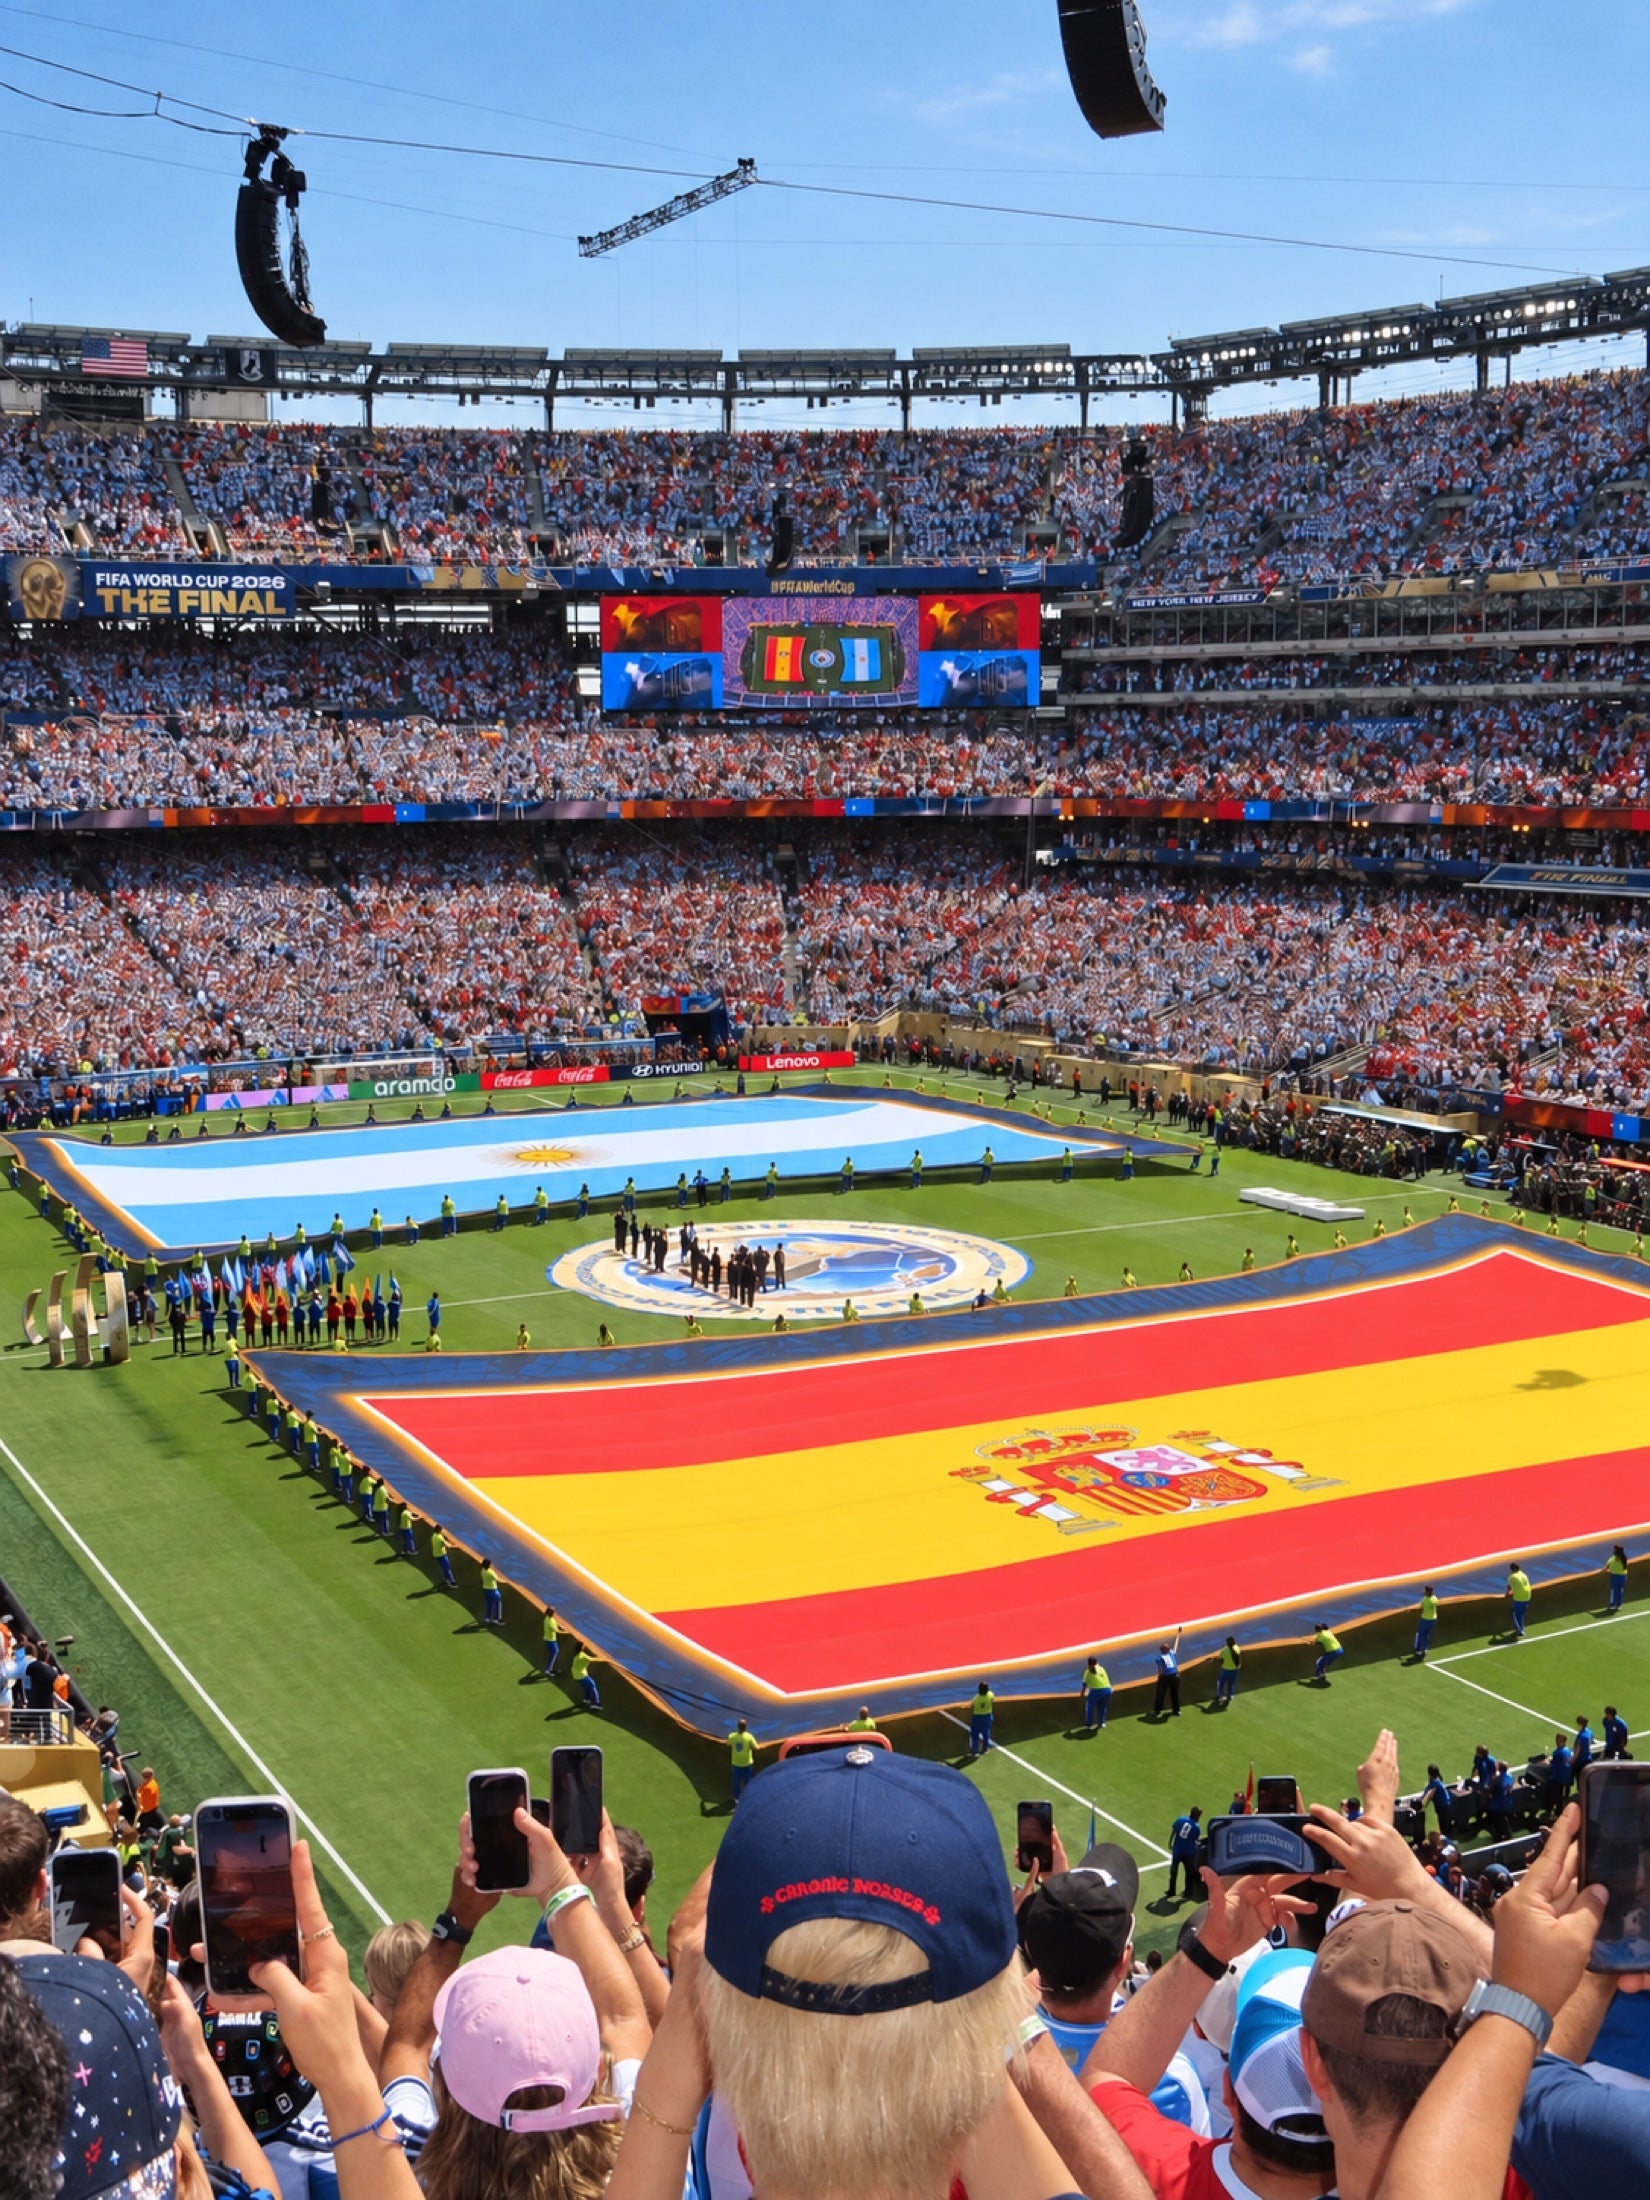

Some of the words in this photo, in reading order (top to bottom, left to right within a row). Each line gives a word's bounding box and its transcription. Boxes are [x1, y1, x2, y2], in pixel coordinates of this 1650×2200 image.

[95, 572, 131, 586] FIFA
[133, 573, 192, 587] WORLD
[195, 575, 229, 588] CUP
[231, 575, 286, 589] 2026
[96, 588, 172, 614] THE
[178, 589, 286, 615] FINAL
[766, 1056, 820, 1069] Lenovo
[374, 1076, 456, 1096] aramco
